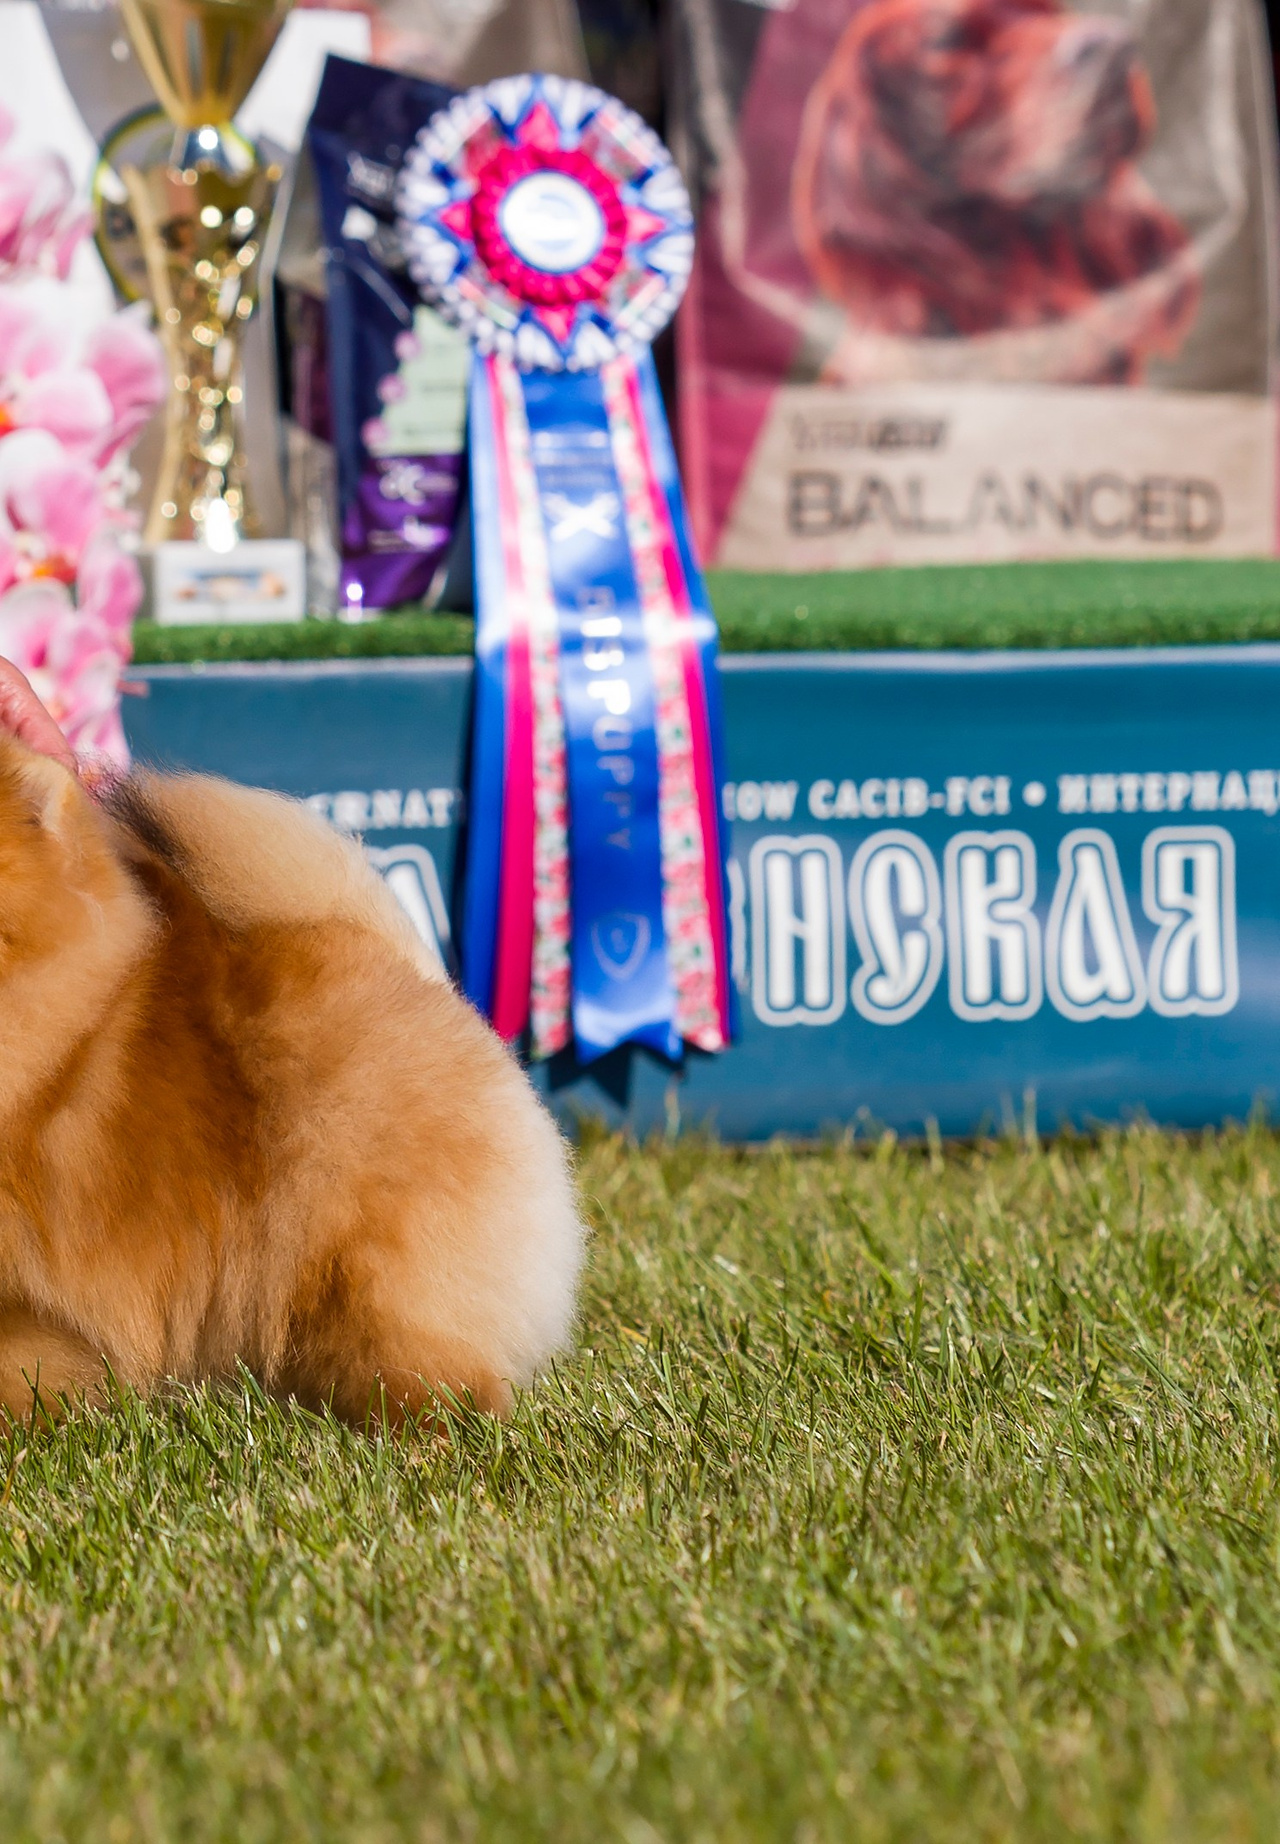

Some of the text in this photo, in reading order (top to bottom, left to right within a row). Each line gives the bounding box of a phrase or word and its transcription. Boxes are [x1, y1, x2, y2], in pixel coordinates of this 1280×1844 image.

[787, 468, 1224, 543] BALANCED
[808, 775, 1011, 820] CACIB-FCI
[1057, 768, 1280, 817] ИНТЕРНАЦ
[728, 826, 1240, 1026] НСКАЯ
